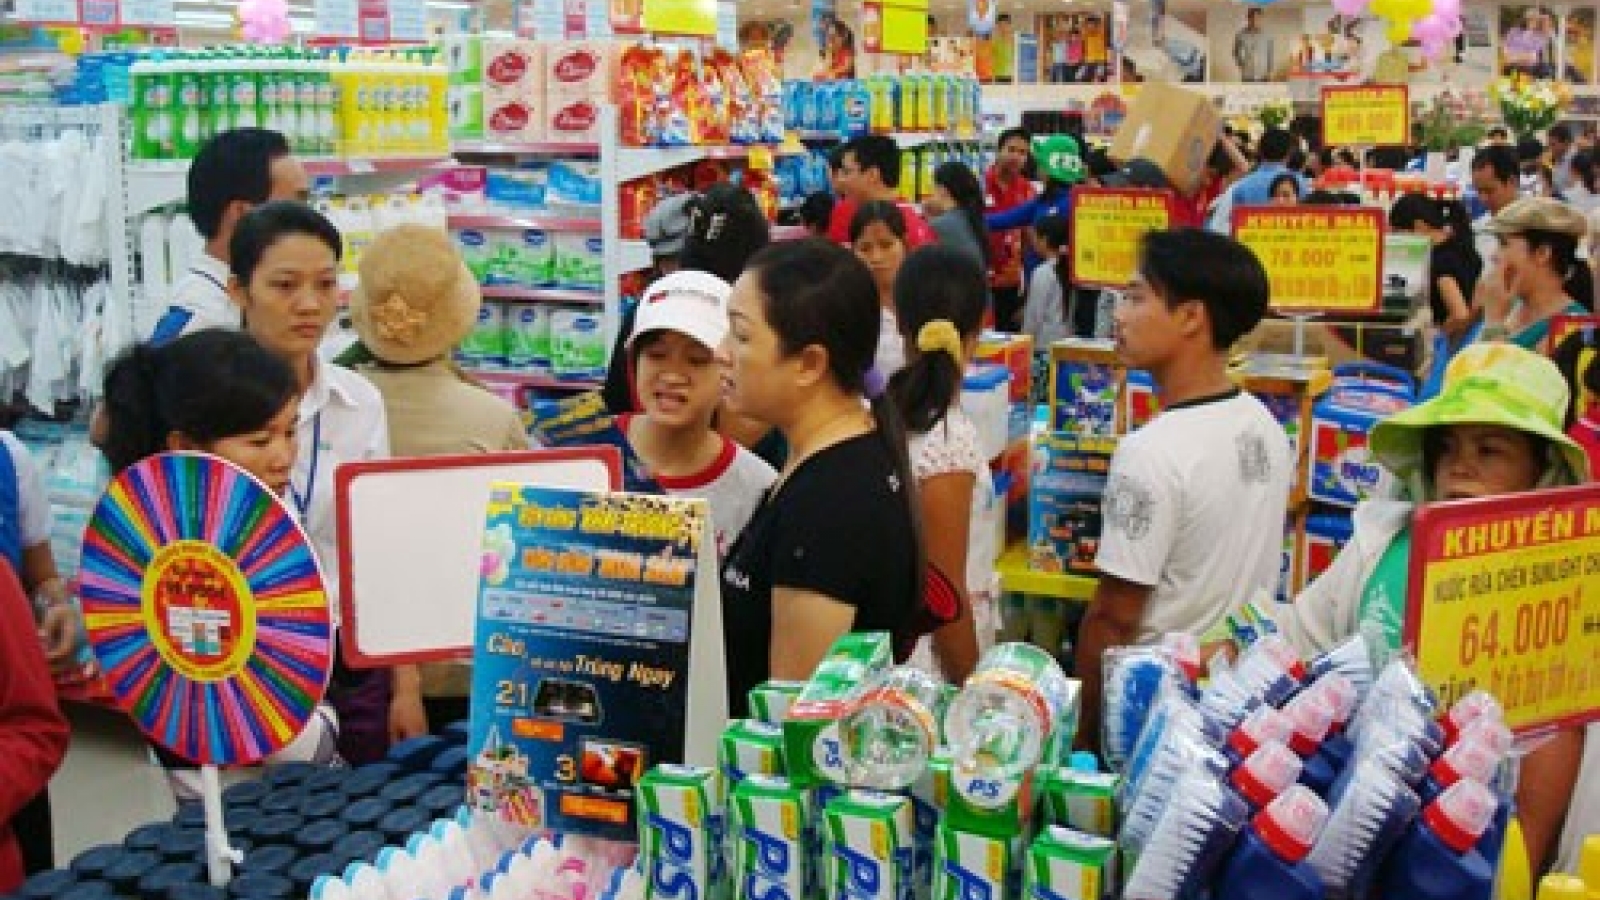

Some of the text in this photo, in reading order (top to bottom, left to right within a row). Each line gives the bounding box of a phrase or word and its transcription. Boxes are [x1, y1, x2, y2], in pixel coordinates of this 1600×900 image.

[1443, 507, 1575, 557] KHUYẾN
[495, 680, 528, 707] 21
[554, 754, 577, 781] 3
